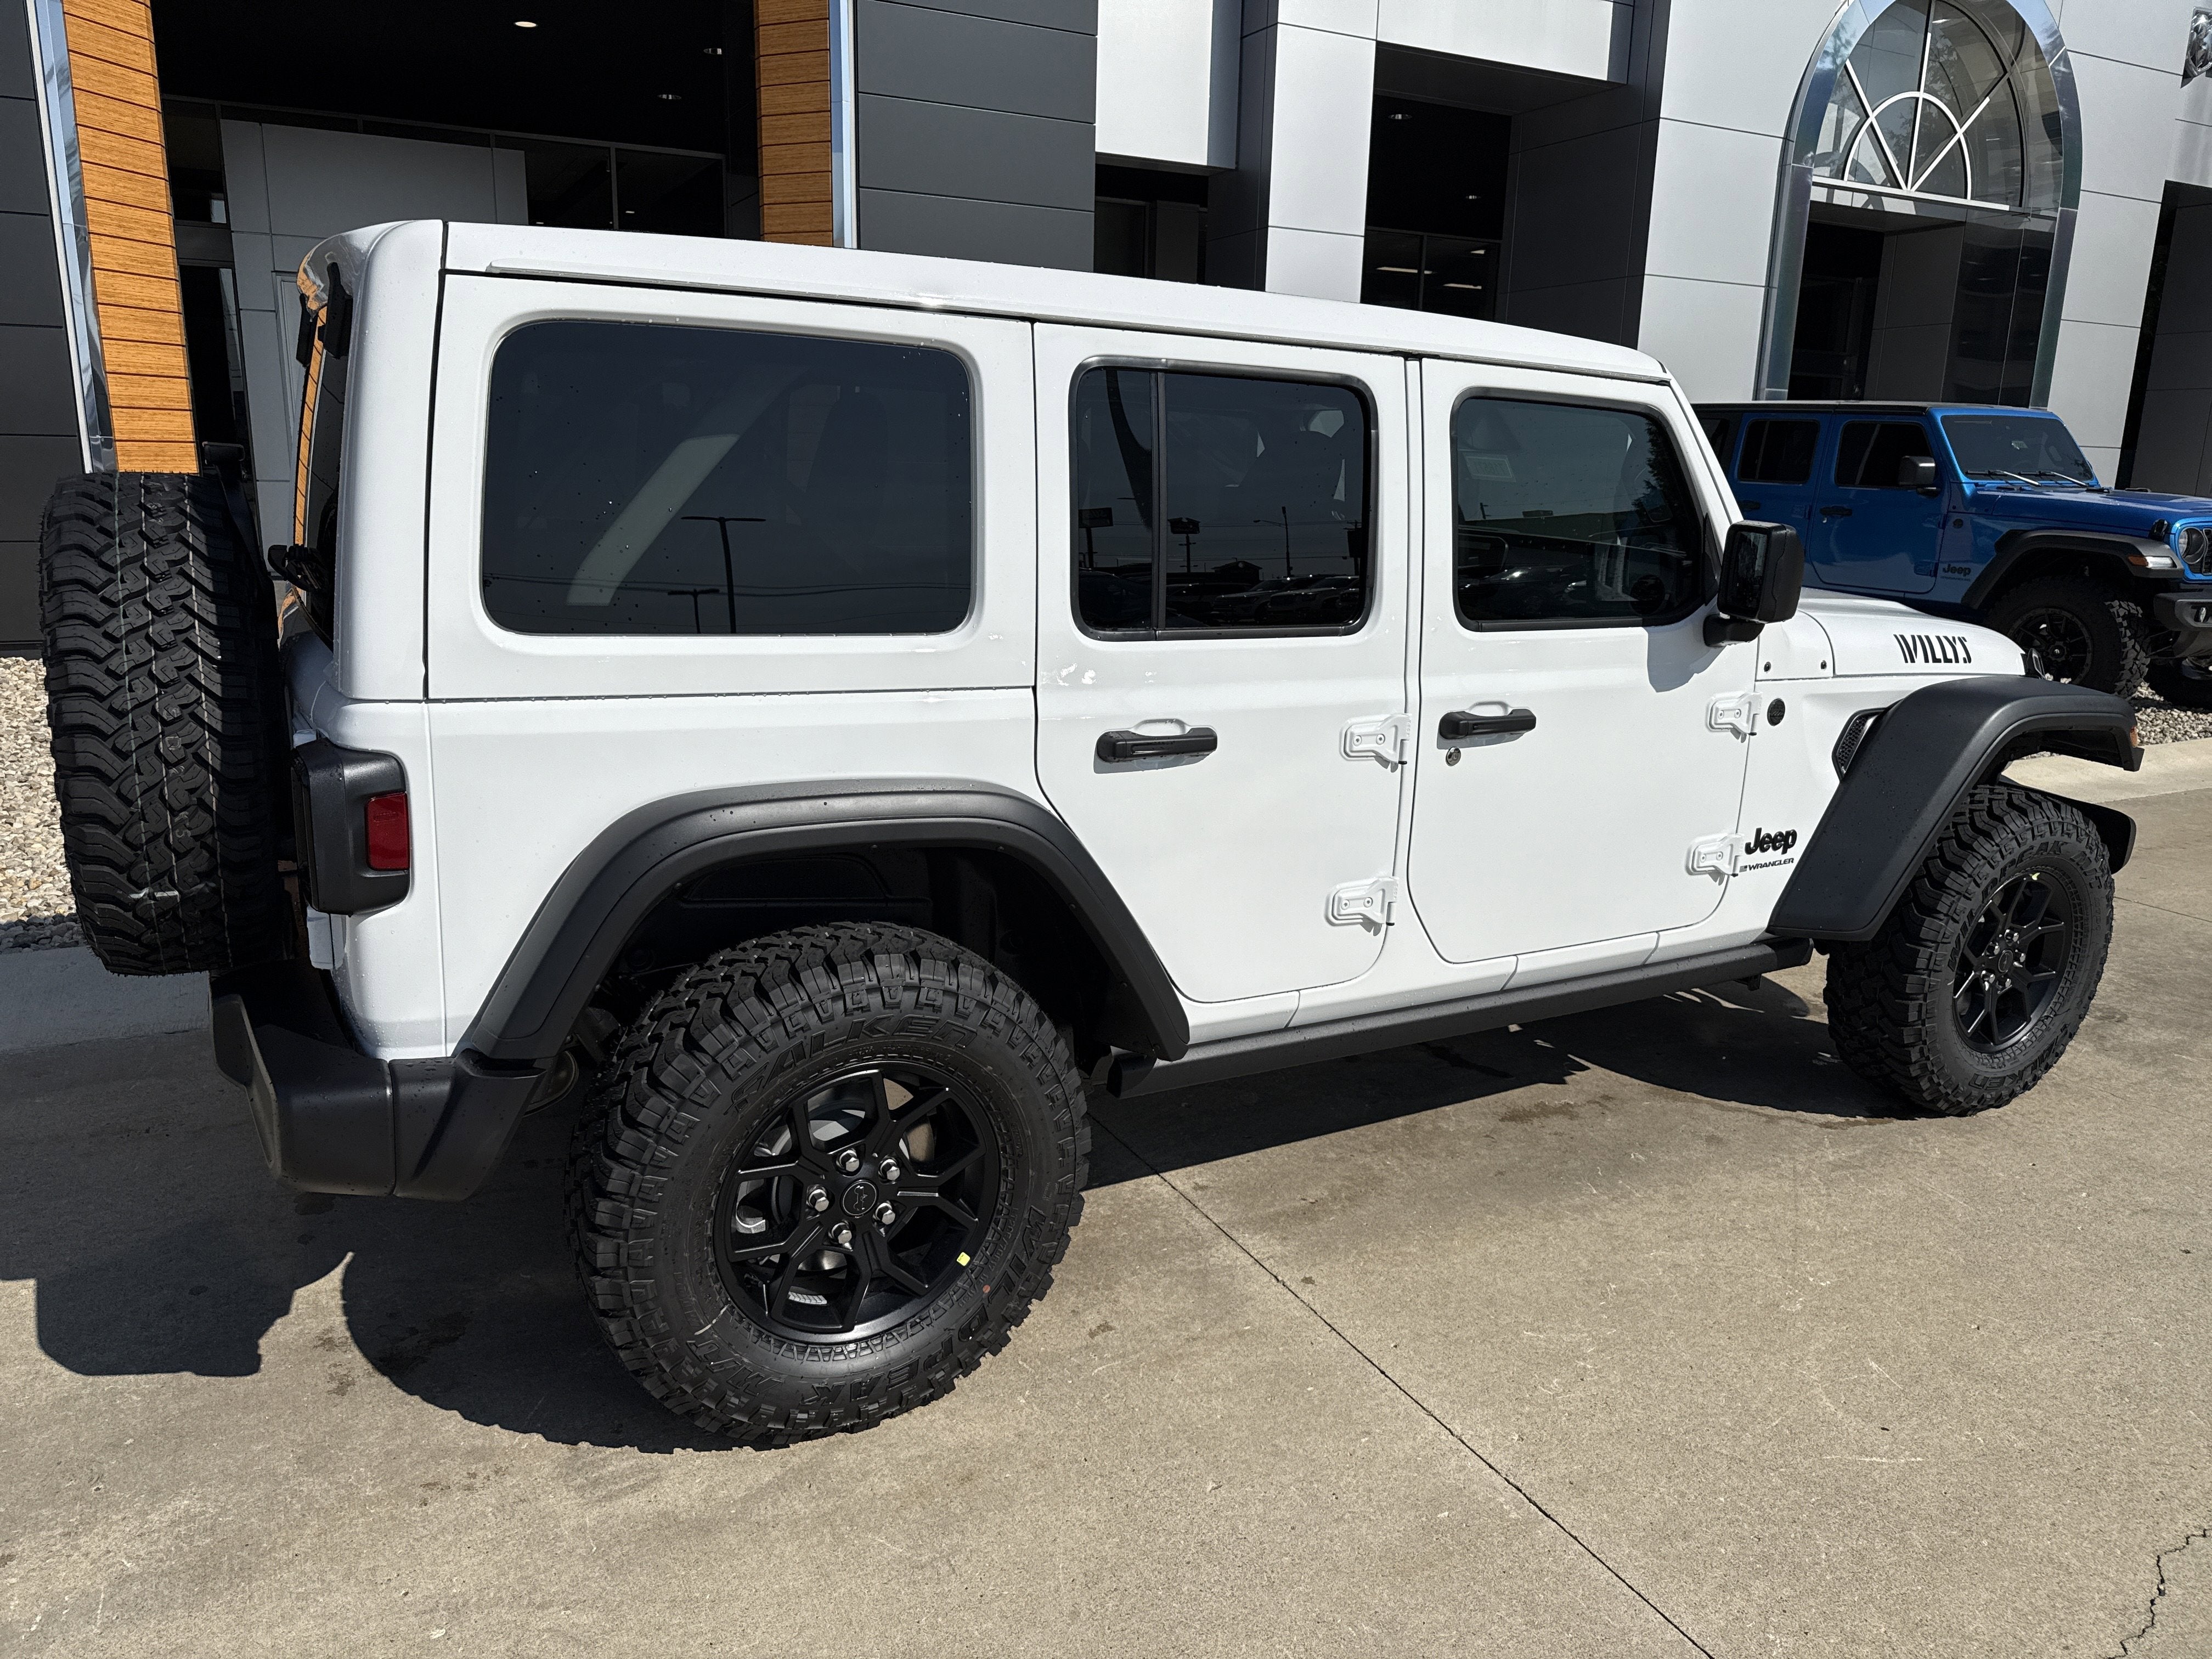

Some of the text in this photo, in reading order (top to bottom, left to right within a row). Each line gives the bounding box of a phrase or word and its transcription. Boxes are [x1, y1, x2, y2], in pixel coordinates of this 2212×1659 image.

[1943, 563, 1971, 577] Jeep
[1893, 634, 1972, 664] WILLYS
[1745, 827, 1797, 855] Jeep
[1748, 858, 1794, 871] WRANGLER
[799, 1205, 1047, 1406] WILDPEAK
